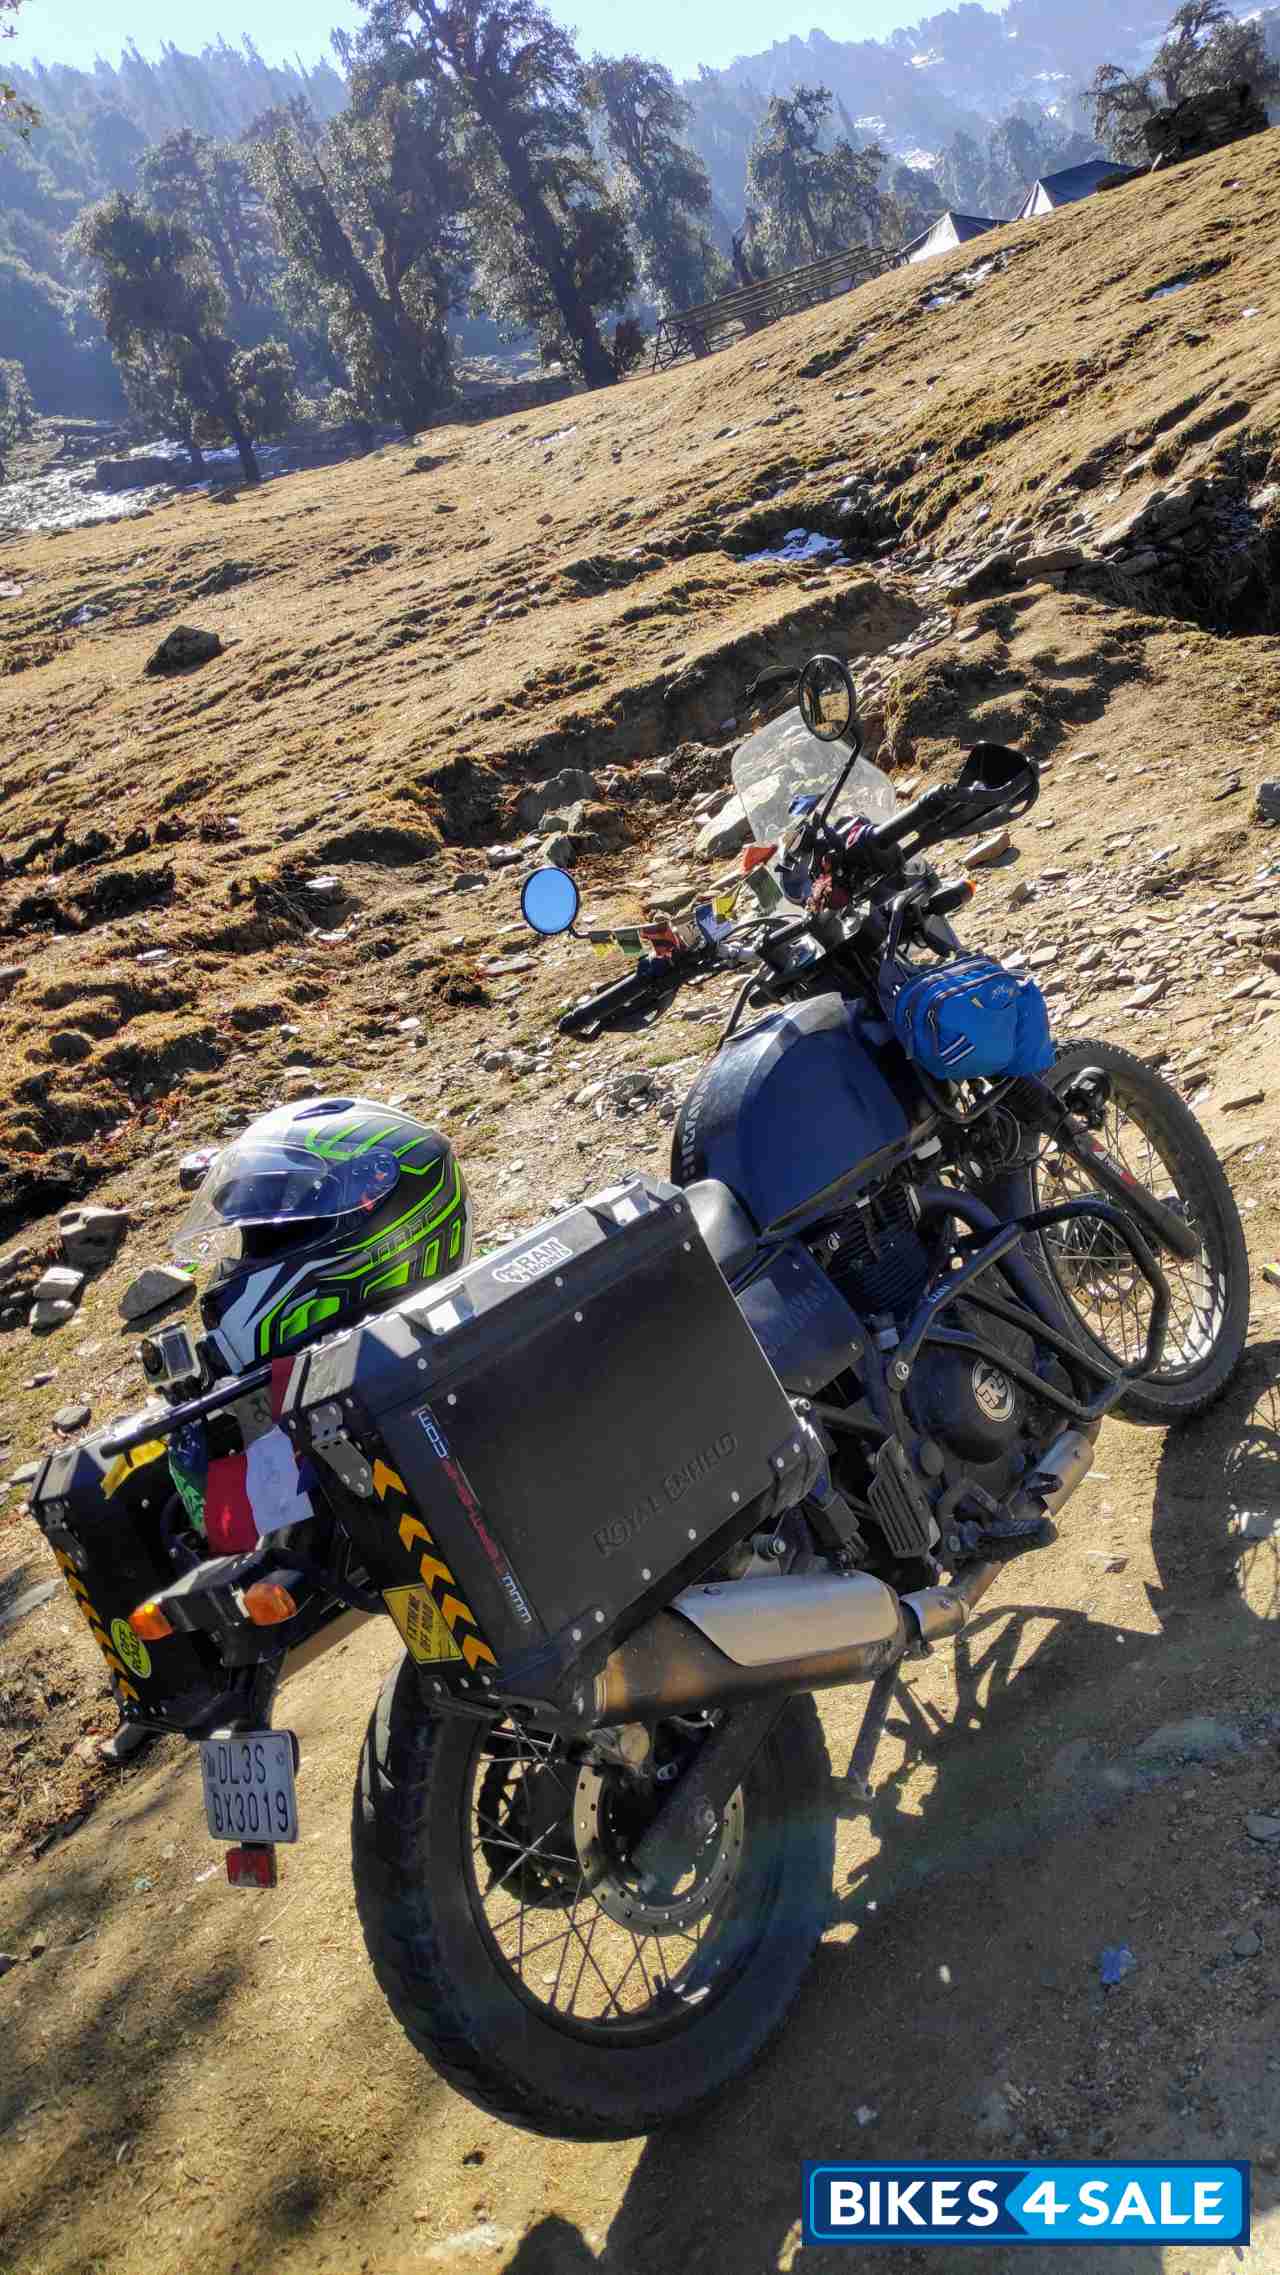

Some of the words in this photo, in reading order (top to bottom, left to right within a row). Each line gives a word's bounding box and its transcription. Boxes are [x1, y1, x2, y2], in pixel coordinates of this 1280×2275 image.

[516, 1240, 563, 1270] RAM
[592, 1495, 664, 1558] ROYAL
[217, 1743, 267, 1785] DL3S
